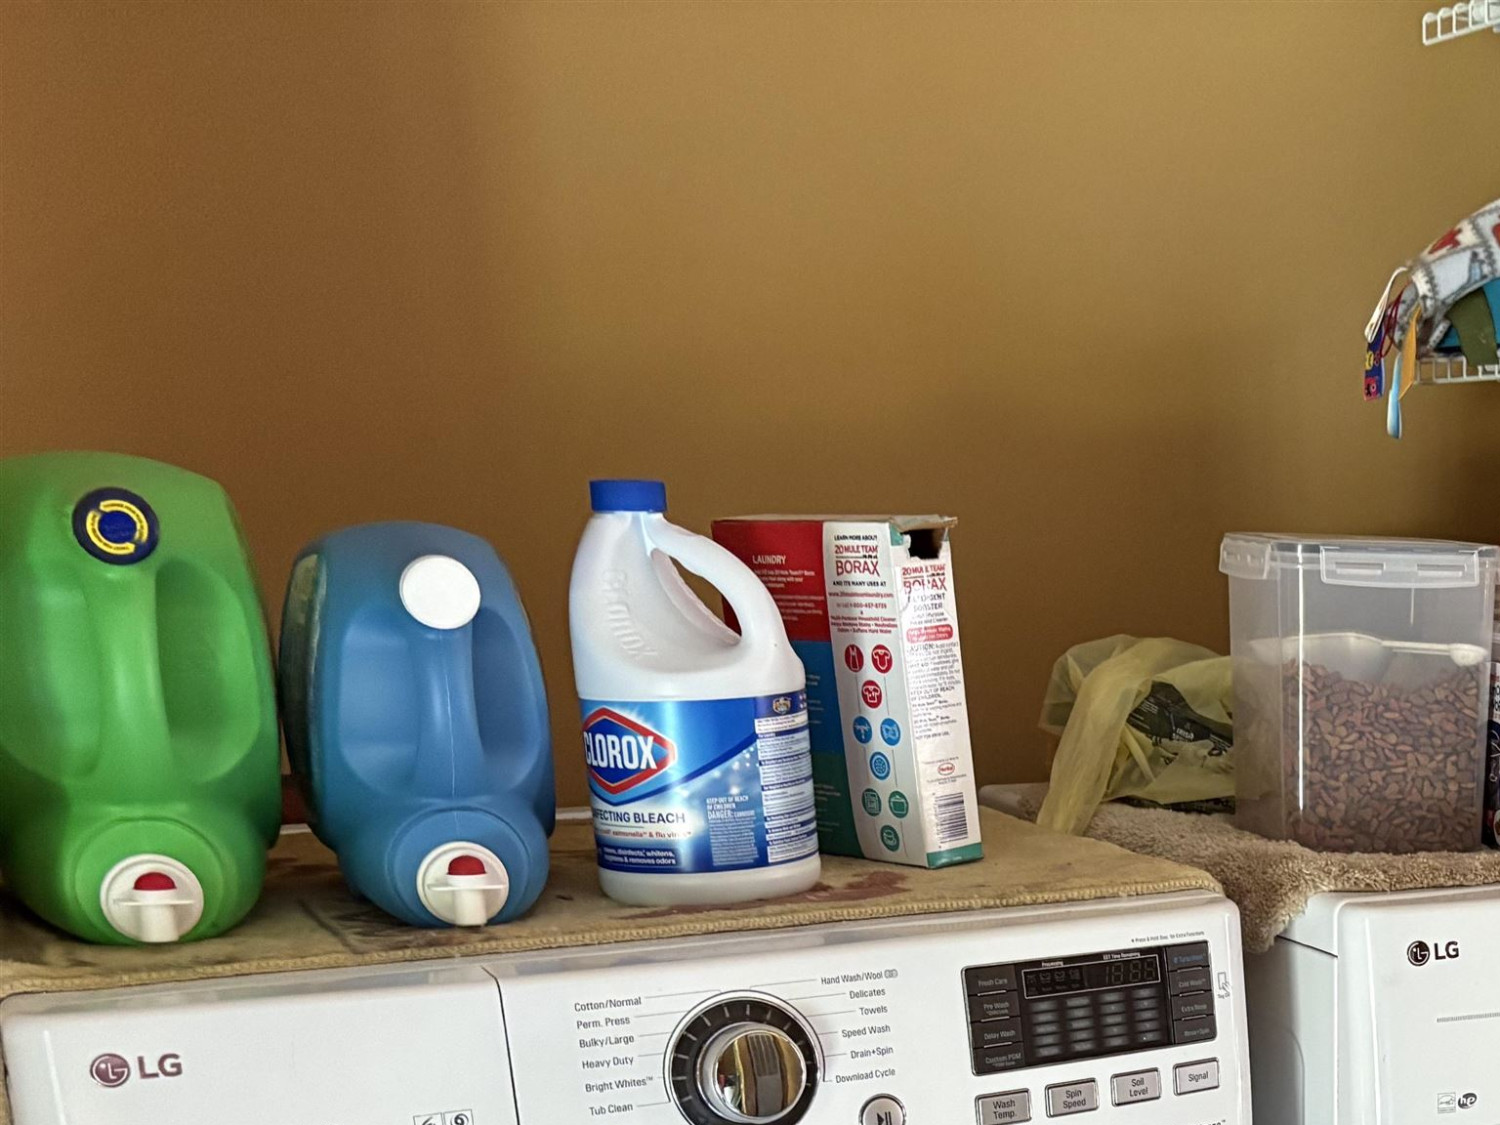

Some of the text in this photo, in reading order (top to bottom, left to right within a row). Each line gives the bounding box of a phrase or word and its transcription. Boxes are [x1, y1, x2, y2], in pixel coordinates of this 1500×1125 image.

[834, 545, 878, 554] 20 MULE TEAM
[752, 555, 786, 564] LAUNDRY
[836, 560, 880, 577] BORAX
[902, 567, 912, 576] 20
[583, 731, 657, 770] CLOROX
[634, 812, 686, 824] BLEACH
[1434, 940, 1460, 960] LG
[821, 970, 883, 985] Hand Wash/Wool
[849, 987, 886, 1000] Delicates
[573, 996, 642, 1012] Cotton/Normal
[859, 1004, 888, 1015] Towels
[995, 1000, 1010, 1010] Wash
[576, 1015, 631, 1030] Perm. Press
[841, 1023, 891, 1039] Speed Wash
[984, 1029, 1016, 1041] Delay Wash
[578, 1033, 635, 1050] Bulky/Large
[850, 1045, 894, 1060] Drain+Spin
[581, 1055, 634, 1070] Heavy Duty
[985, 1054, 1007, 1064] Custom
[138, 1053, 183, 1080] LG
[835, 1067, 896, 1084] Download Cycle
[1188, 1071, 1209, 1082] Signal
[585, 1079, 613, 1094] Bright
[1131, 1078, 1144, 1088] Soil
[1065, 1089, 1082, 1100] Spin
[1129, 1087, 1149, 1098] Level
[589, 1102, 633, 1117] Tub Clean
[992, 1099, 1016, 1110] Wash
[1063, 1098, 1086, 1110] Speed
[993, 1109, 1017, 1121] Temp.
